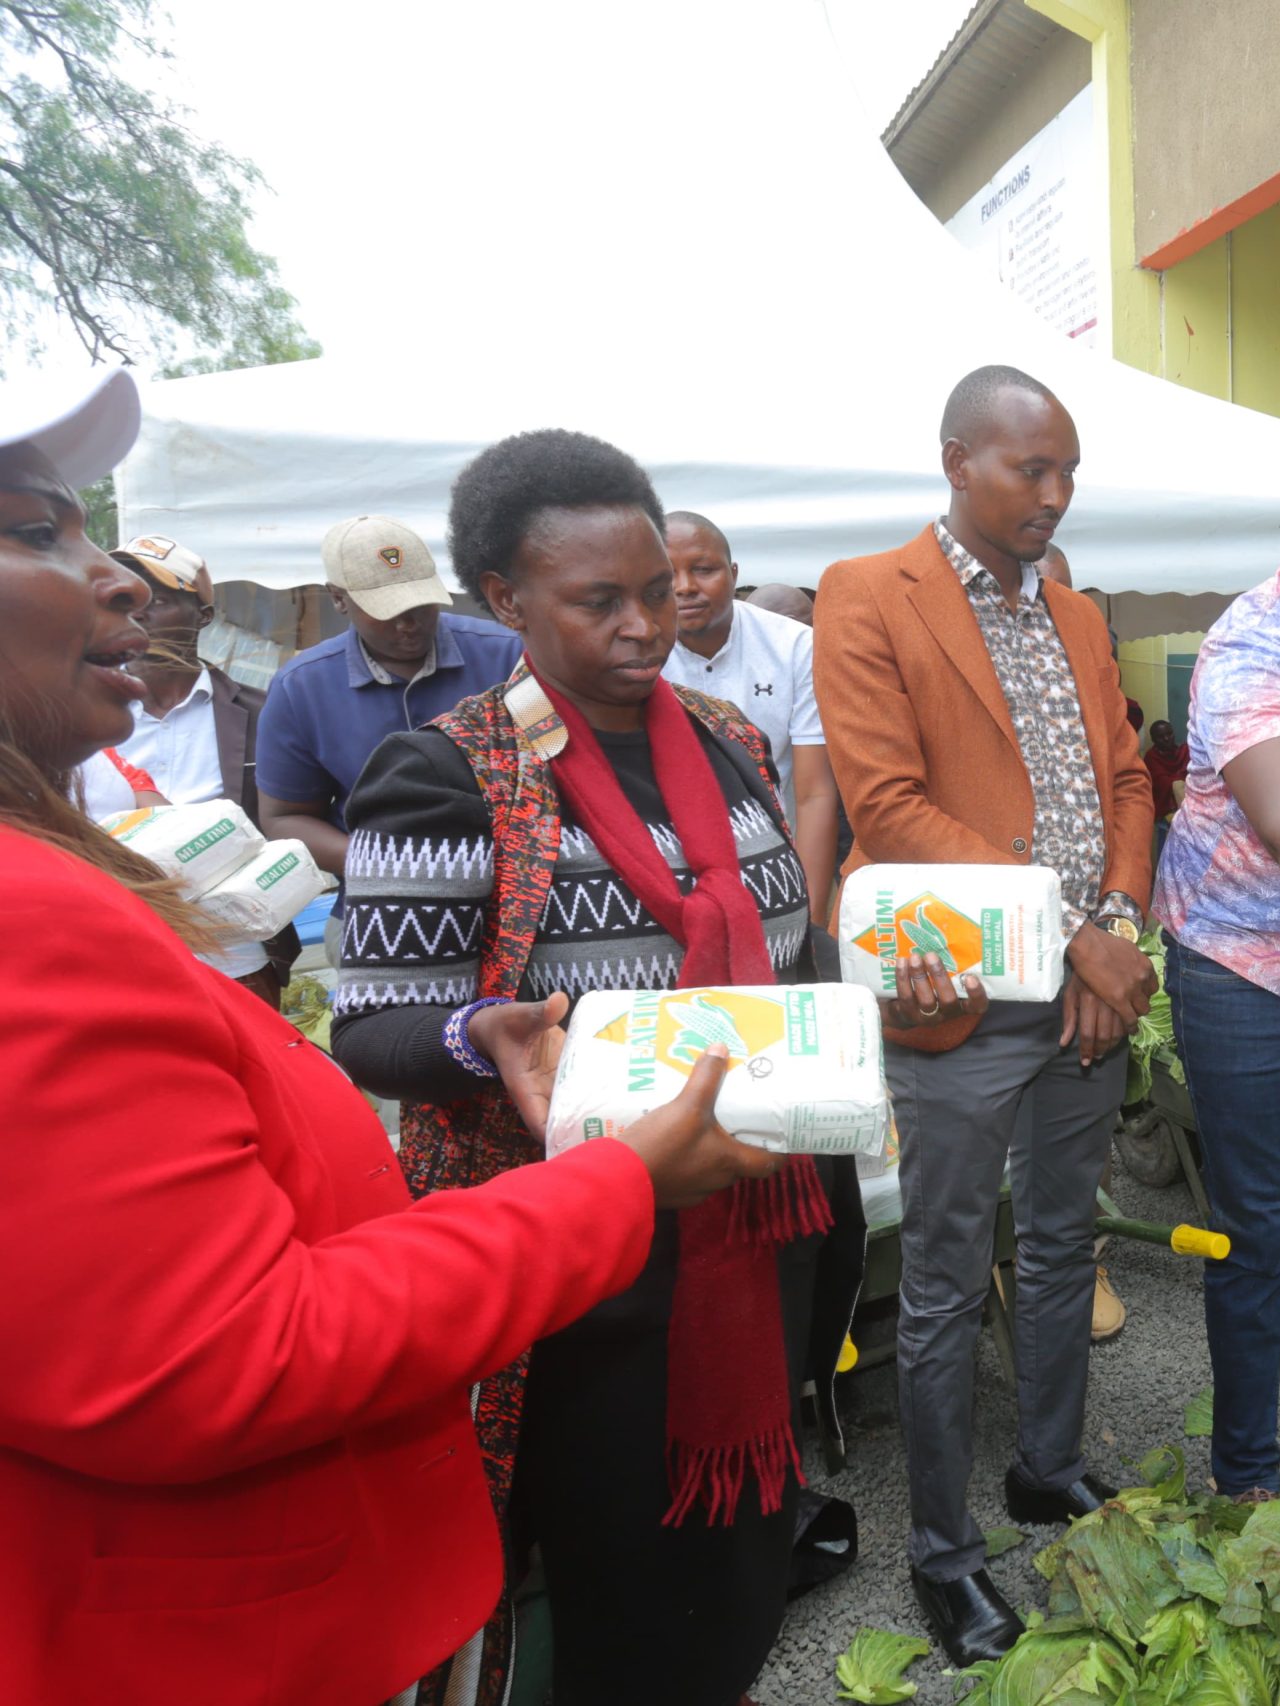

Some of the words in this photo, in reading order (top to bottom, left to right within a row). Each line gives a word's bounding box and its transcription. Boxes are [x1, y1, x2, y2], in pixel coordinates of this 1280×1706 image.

[981, 165, 1030, 221] FUNCTIONS
[178, 821, 234, 862] MEALTIME
[258, 852, 299, 890] MEALTIME
[983, 912, 992, 940] SIFTED
[993, 920, 1002, 941] MEAL
[984, 947, 993, 974] GRADE
[994, 944, 1002, 967] MAIZE
